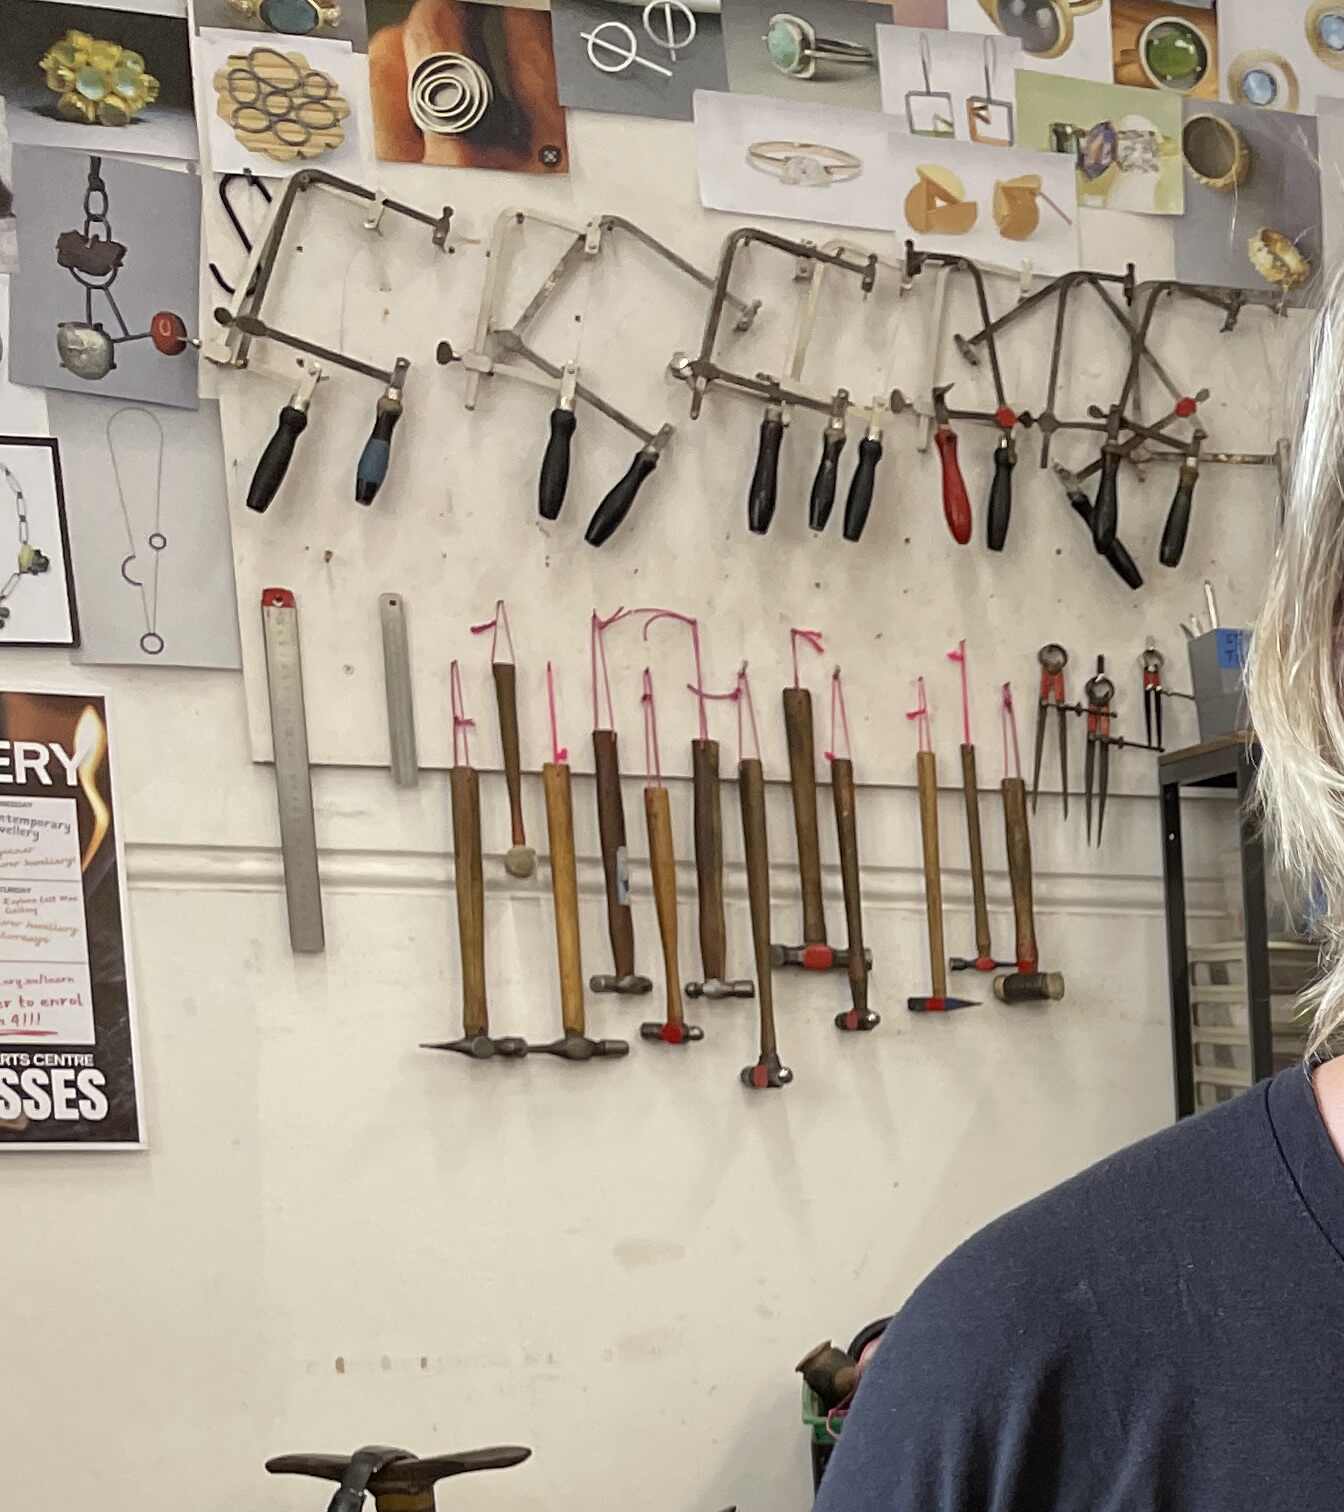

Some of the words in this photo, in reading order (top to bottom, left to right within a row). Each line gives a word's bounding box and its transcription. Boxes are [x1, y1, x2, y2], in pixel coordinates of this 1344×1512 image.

[19, 995, 34, 1008] to
[40, 993, 82, 1008] enrol
[33, 1053, 94, 1067] CENTRE
